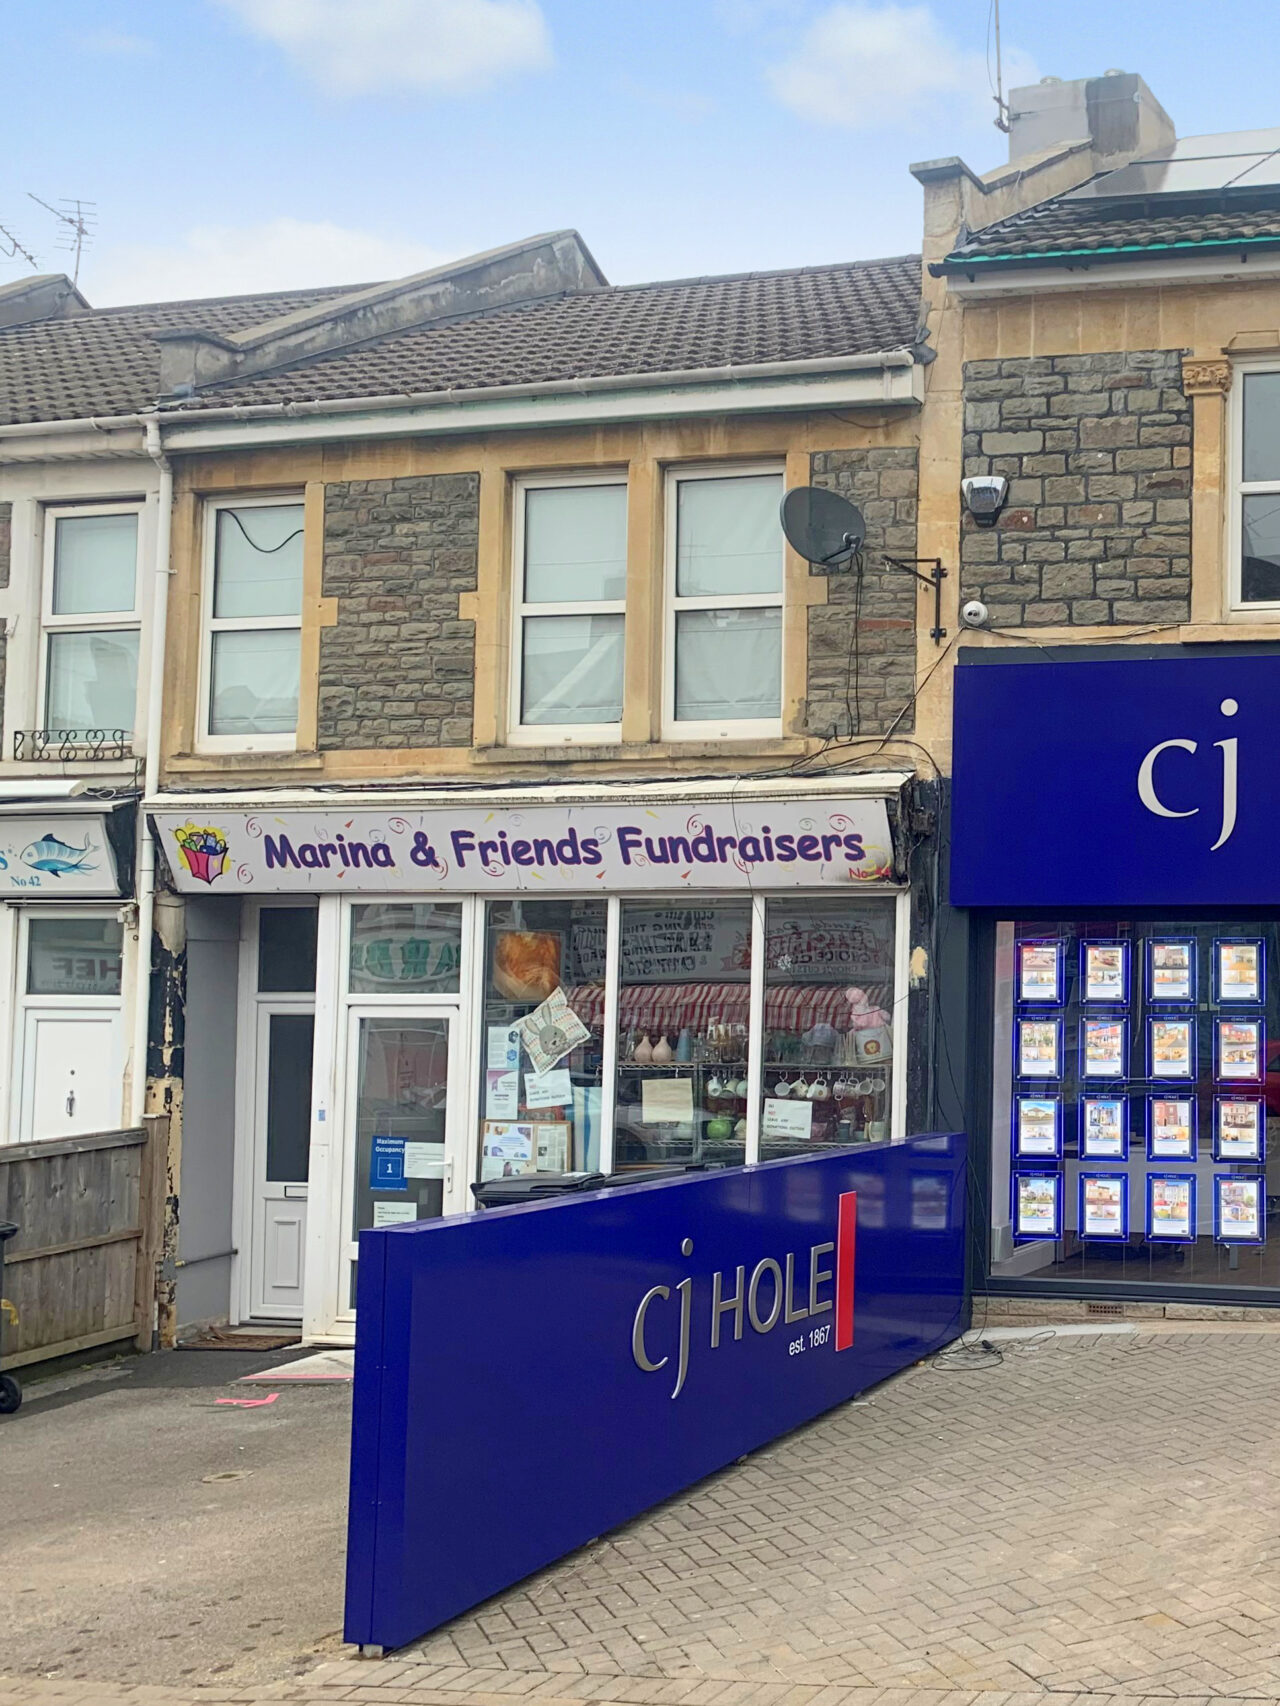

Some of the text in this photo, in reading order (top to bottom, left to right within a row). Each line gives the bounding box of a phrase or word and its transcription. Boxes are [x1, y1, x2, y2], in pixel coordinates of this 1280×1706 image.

[264, 824, 866, 869] Marina & Friends Fundraisers
[10, 876, 41, 887] No 42
[375, 1145, 405, 1154] Occupancy
[386, 1163, 393, 1173] 1
[711, 1241, 835, 1349] HOLE
[788, 1324, 831, 1356] est. 1867
